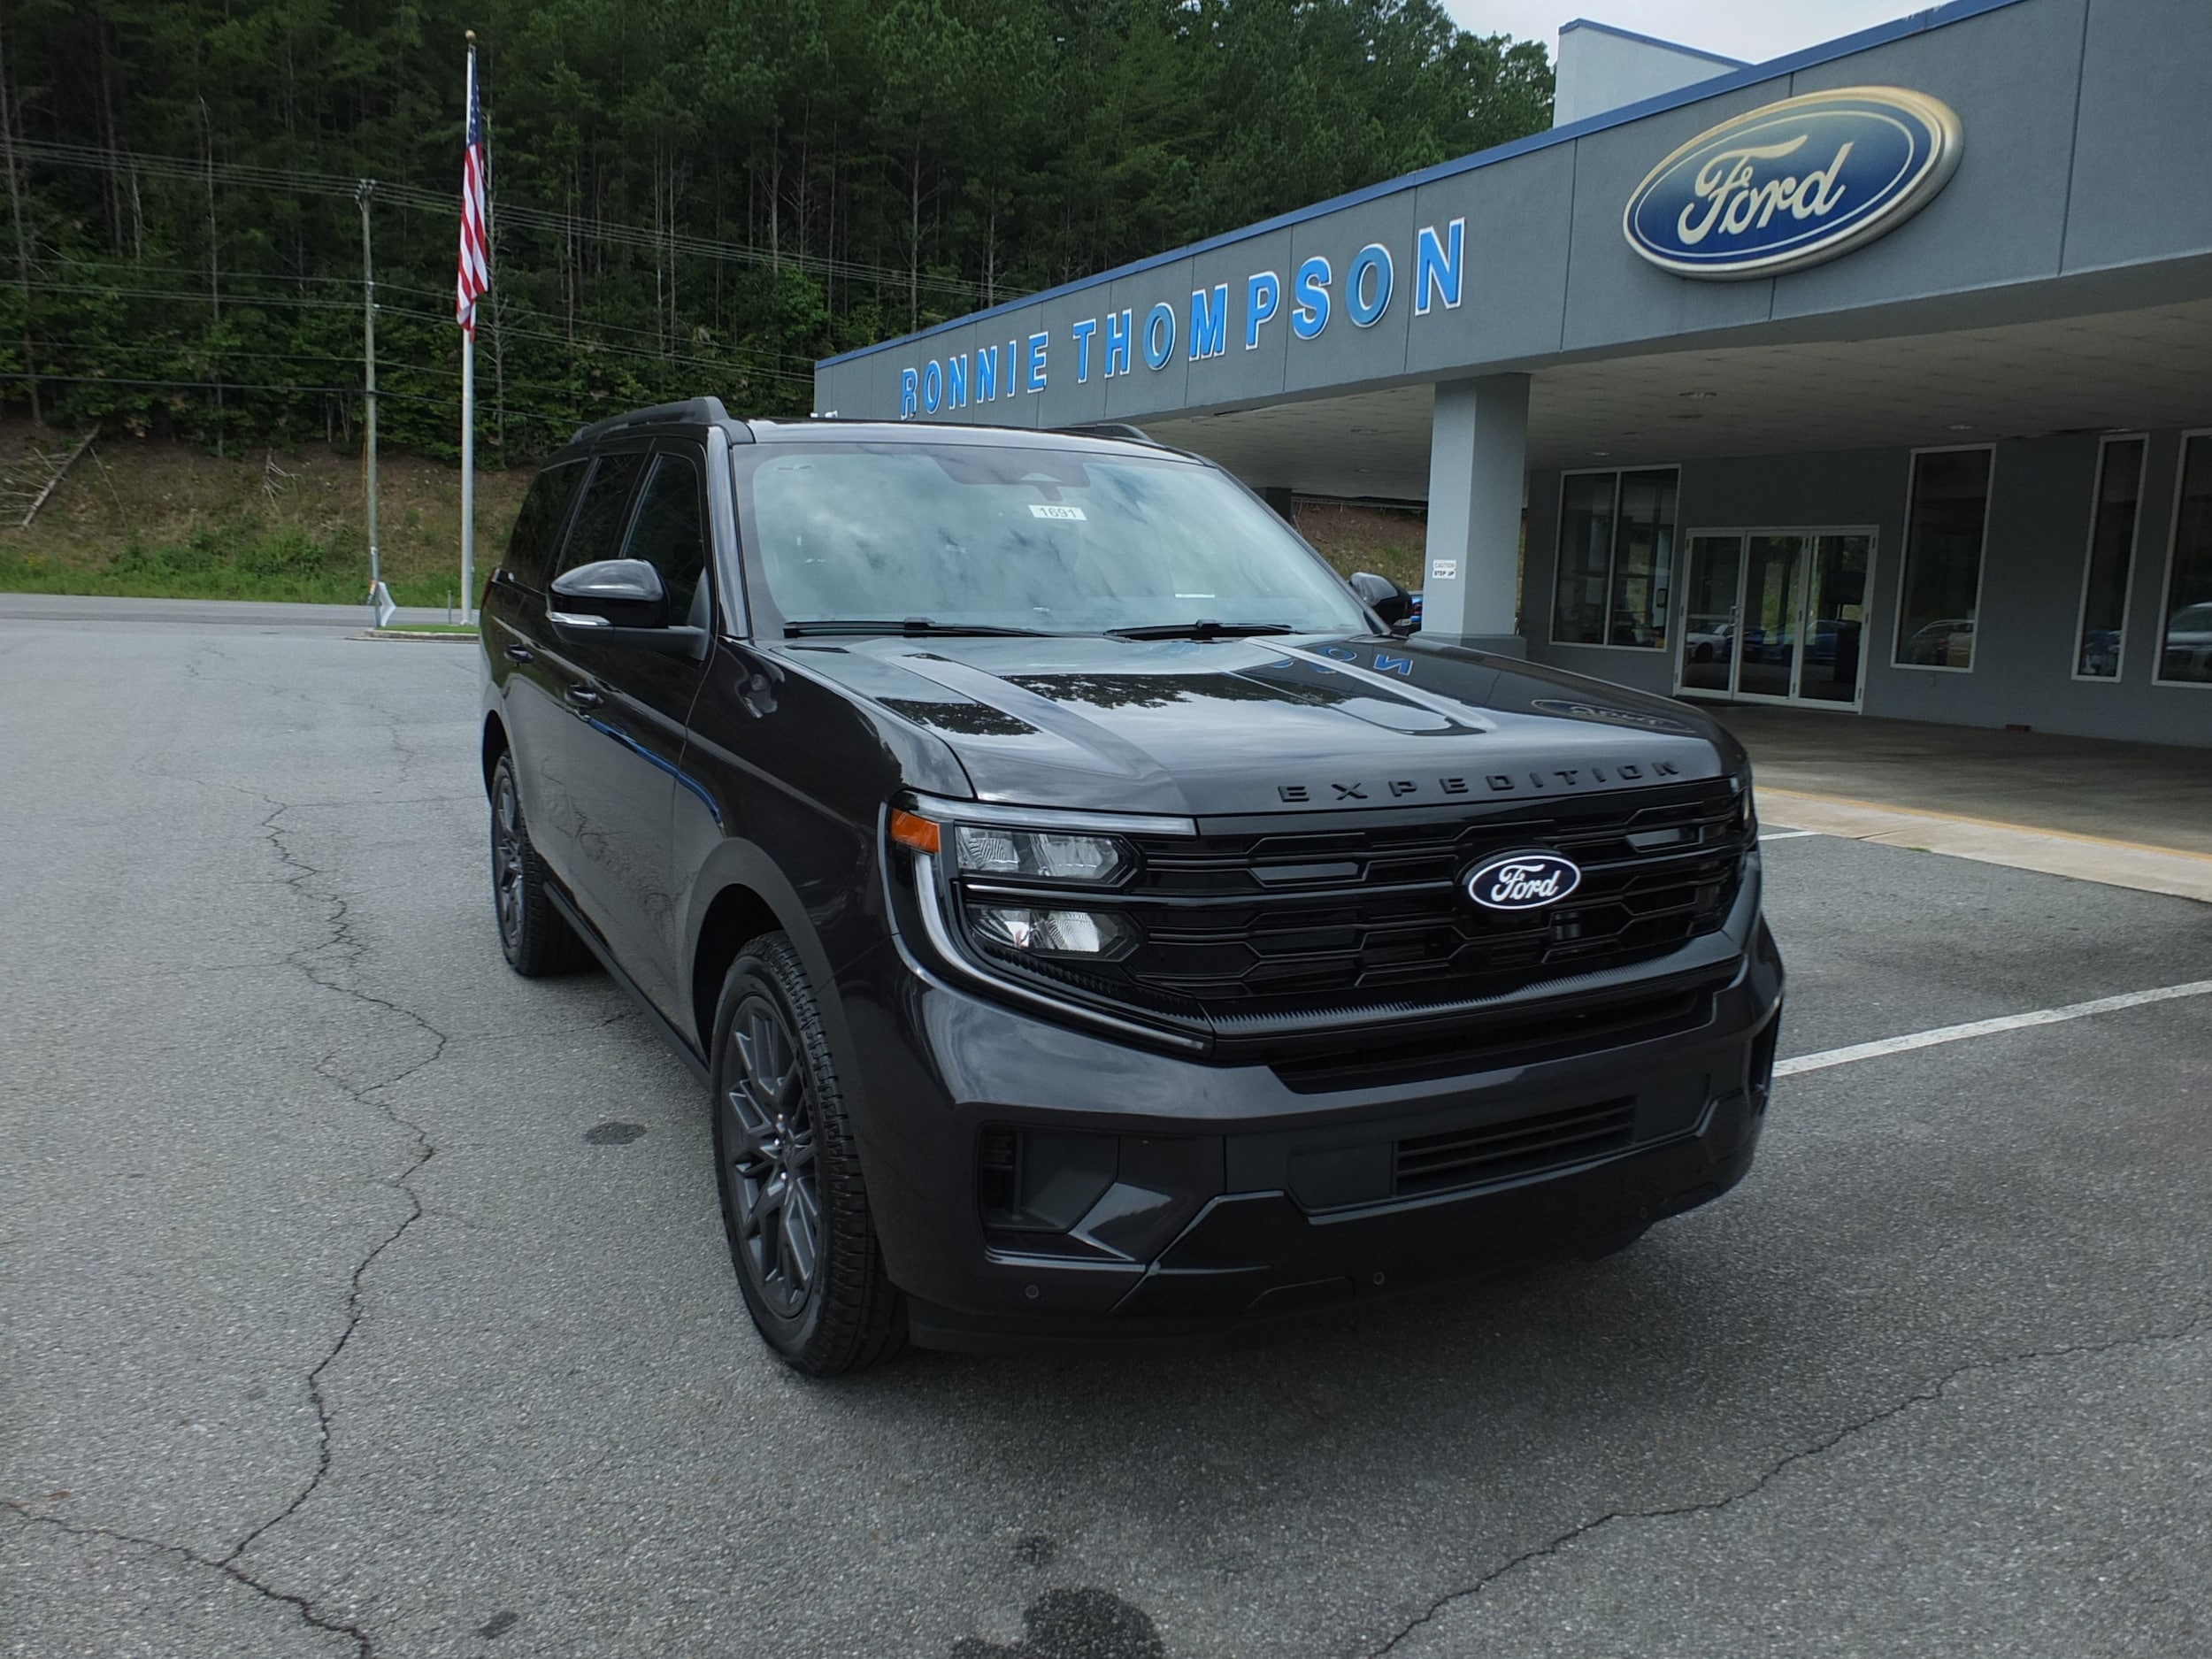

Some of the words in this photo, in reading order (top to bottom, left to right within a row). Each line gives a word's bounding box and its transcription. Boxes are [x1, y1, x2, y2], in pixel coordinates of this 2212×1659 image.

[1678, 134, 1854, 245] Ford
[900, 332, 1049, 420] RONNIE
[1071, 217, 1466, 384] THOMPSON
[1039, 507, 1077, 518] 1691
[1277, 760, 1680, 803] EXPEDITION
[1491, 864, 1561, 902] Ford
